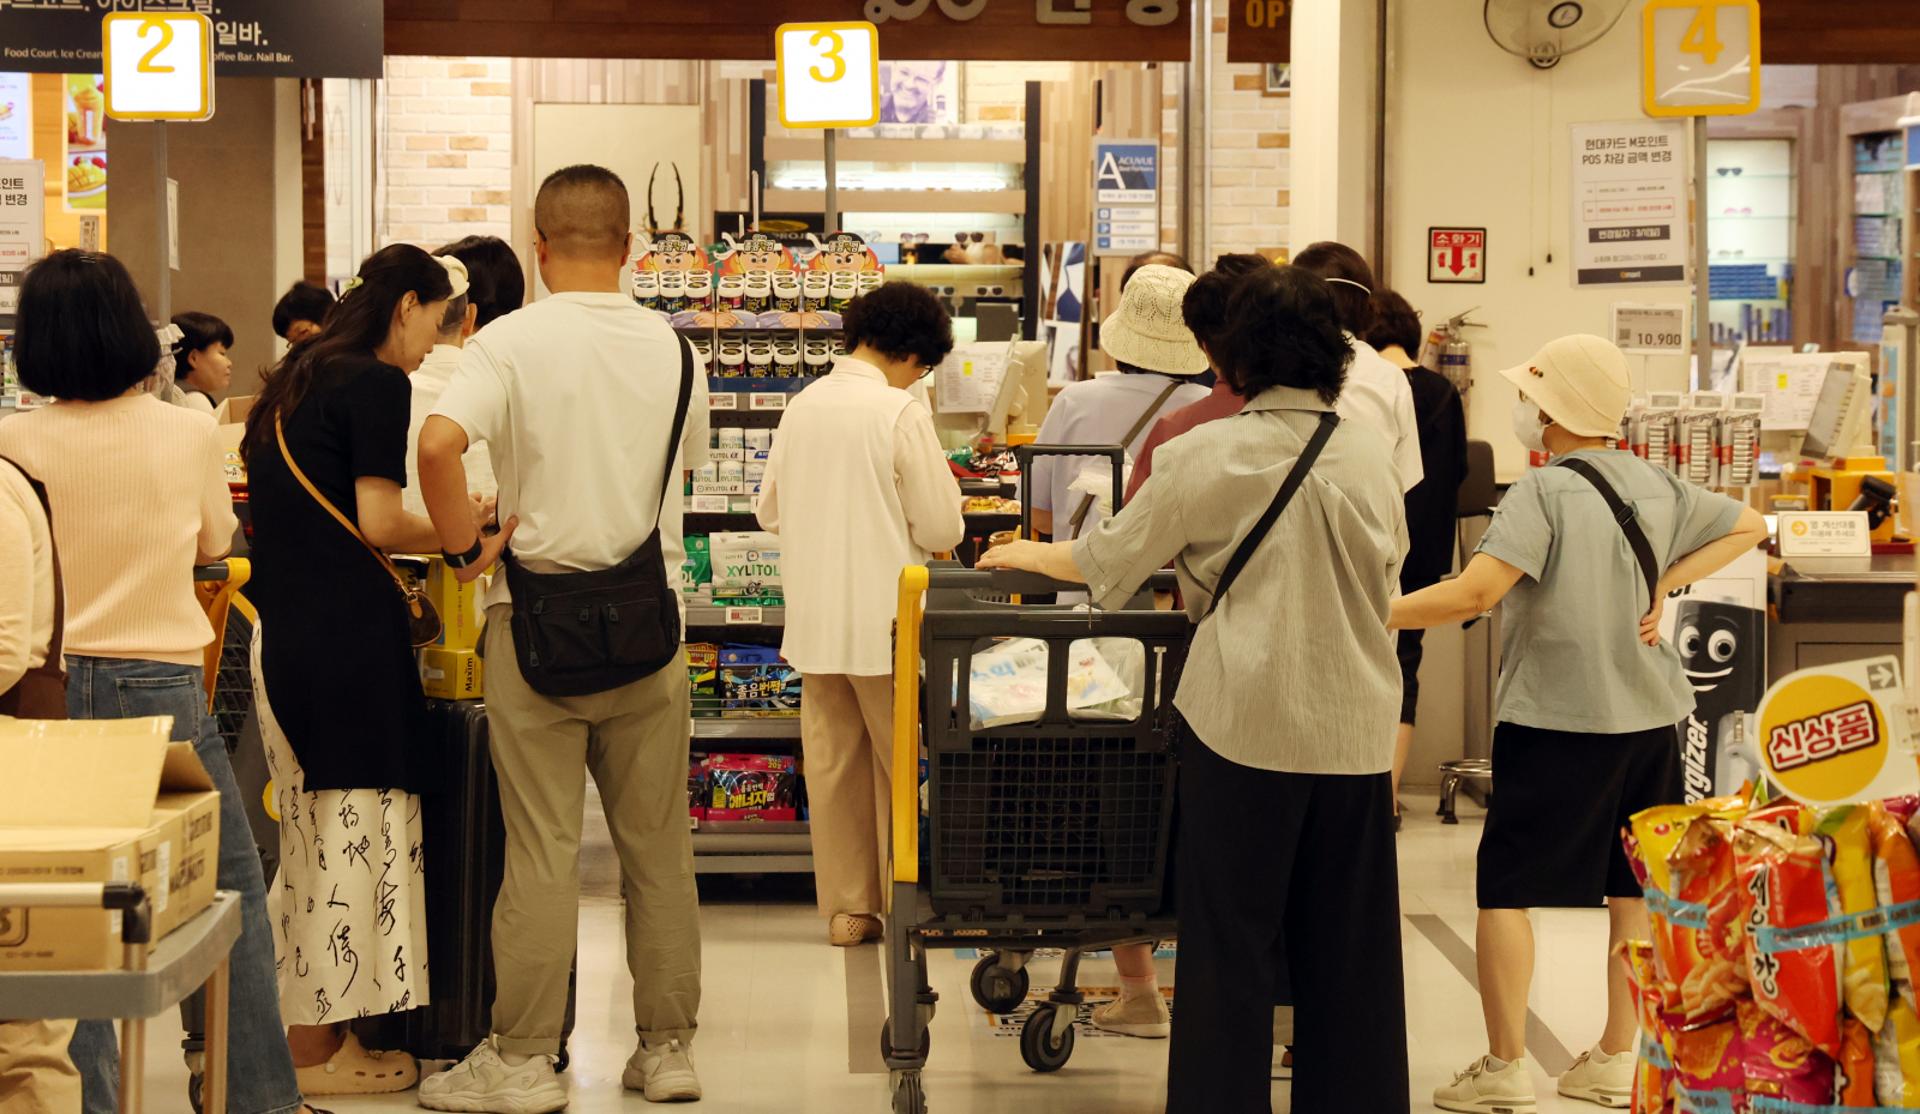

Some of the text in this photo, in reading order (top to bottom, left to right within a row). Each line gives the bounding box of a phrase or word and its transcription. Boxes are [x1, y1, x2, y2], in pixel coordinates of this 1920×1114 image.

[1246, 0, 1291, 28] OP
[136, 17, 176, 73] 2
[215, 22, 269, 46] 일바.
[1679, 4, 1725, 65] 4
[4, 47, 29, 57] Food
[60, 49, 74, 58] Ice
[213, 51, 236, 62] offee
[256, 53, 275, 62] Nail
[276, 53, 294, 62] Bar.
[808, 29, 847, 83] 3
[1585, 138, 1627, 150] 현대카드
[1582, 154, 1601, 165] POS
[1651, 151, 1672, 162] 변경
[1098, 151, 1126, 190] A
[0, 178, 23, 190] 인트
[5, 194, 28, 206] 변경
[1437, 233, 1480, 244] 소화기
[727, 564, 780, 576] XYLITOL
[464, 657, 473, 692] Maxim
[1768, 701, 1879, 771] 신상품
